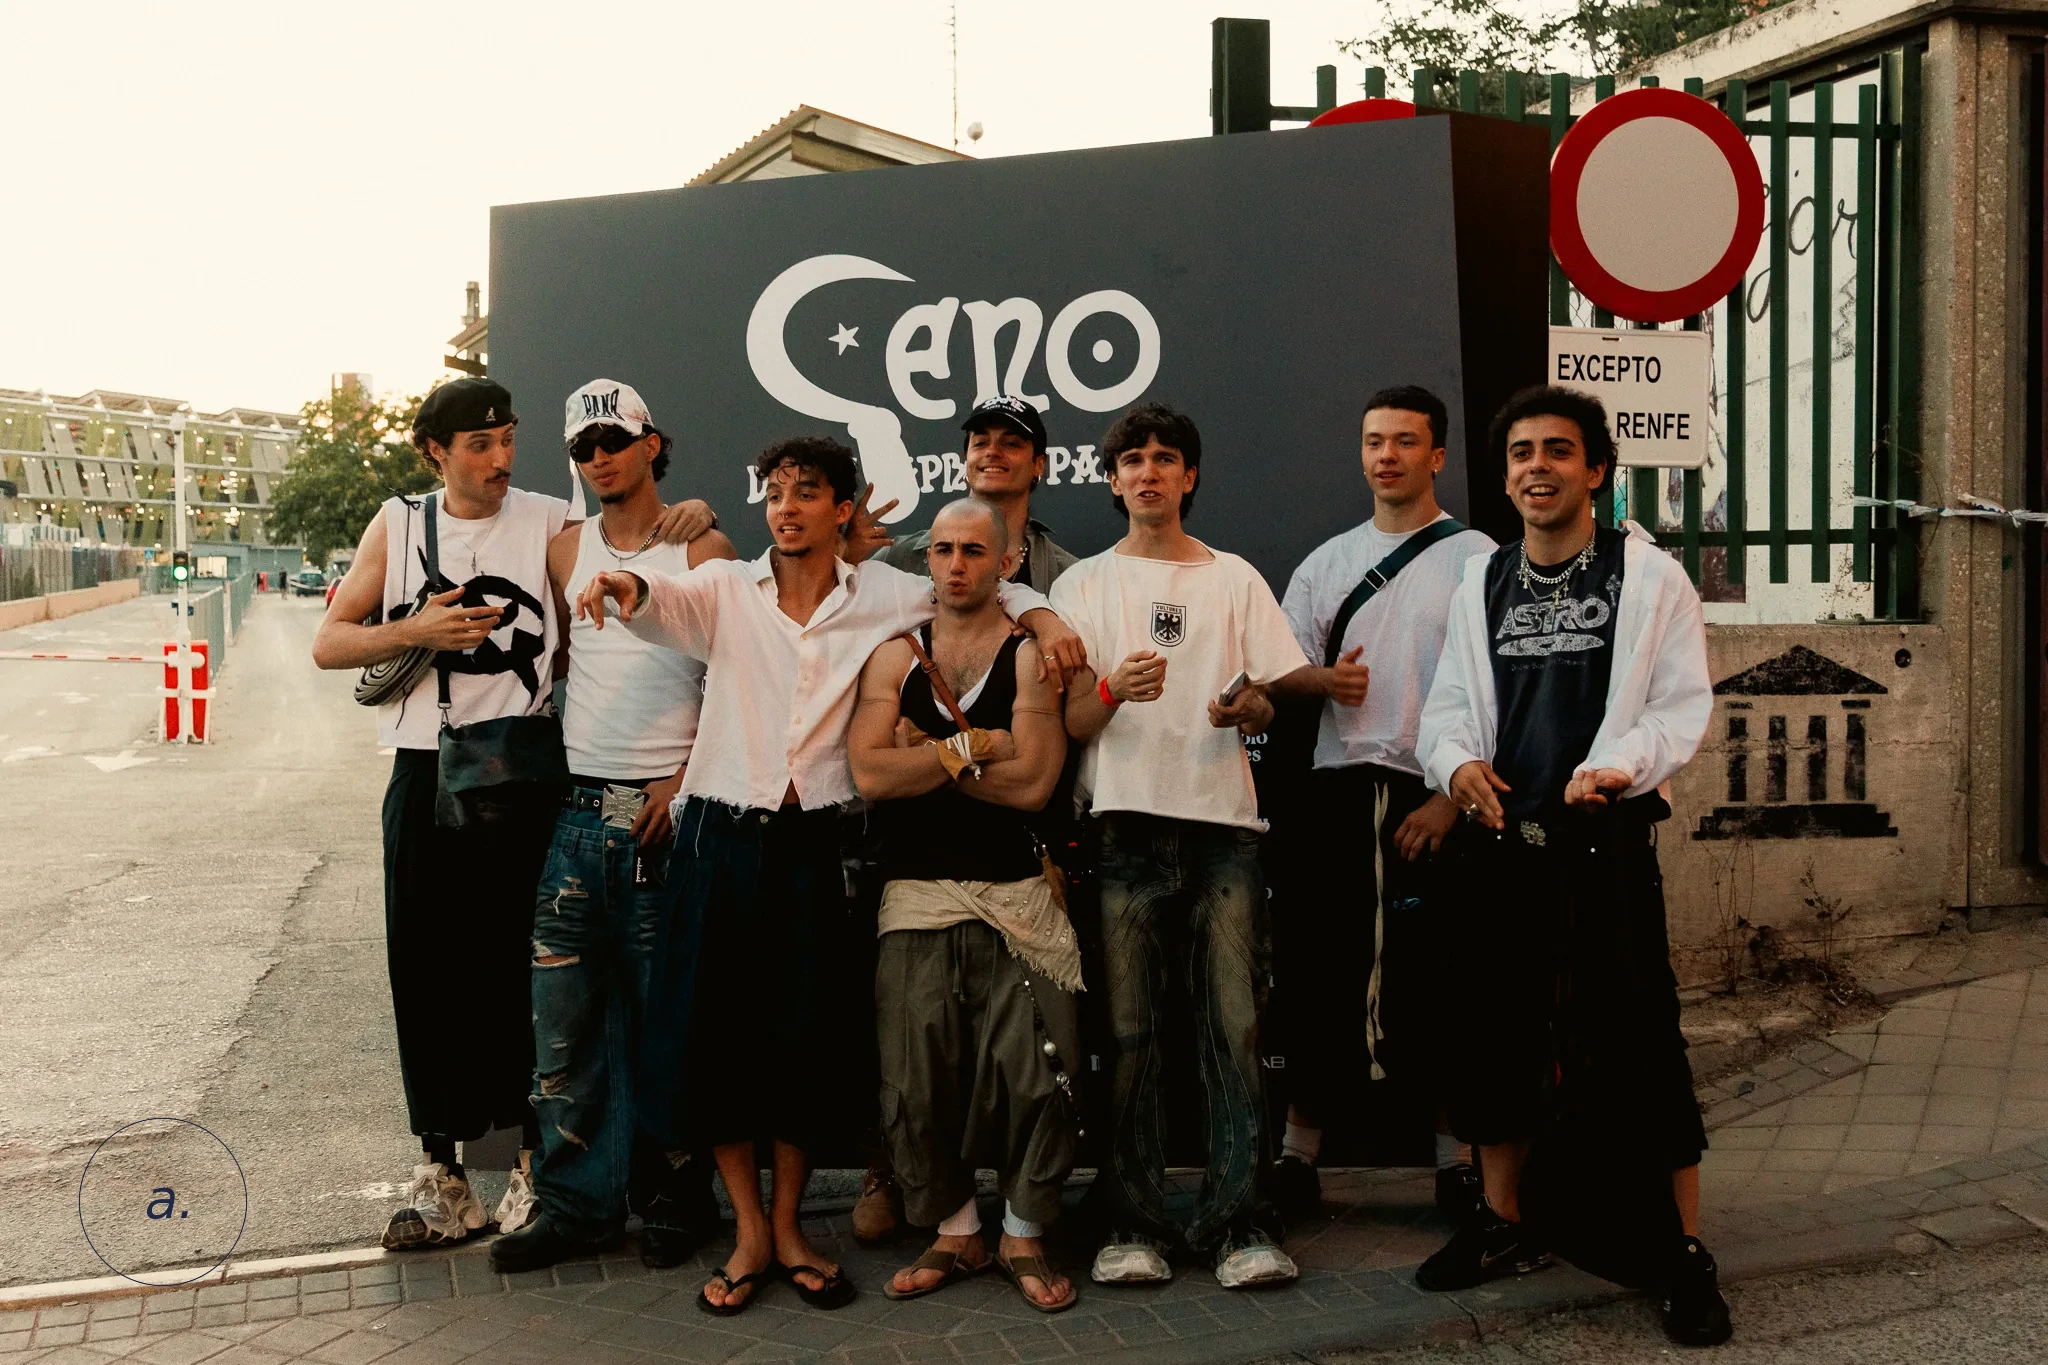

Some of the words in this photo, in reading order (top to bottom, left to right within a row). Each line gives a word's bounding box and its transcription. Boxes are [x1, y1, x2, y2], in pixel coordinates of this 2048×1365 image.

[1557, 354, 1662, 383] EXCEPTO
[1616, 412, 1690, 440] RENFE
[1155, 604, 1183, 613] VULTURES
[1495, 597, 1610, 640] ASTRO
